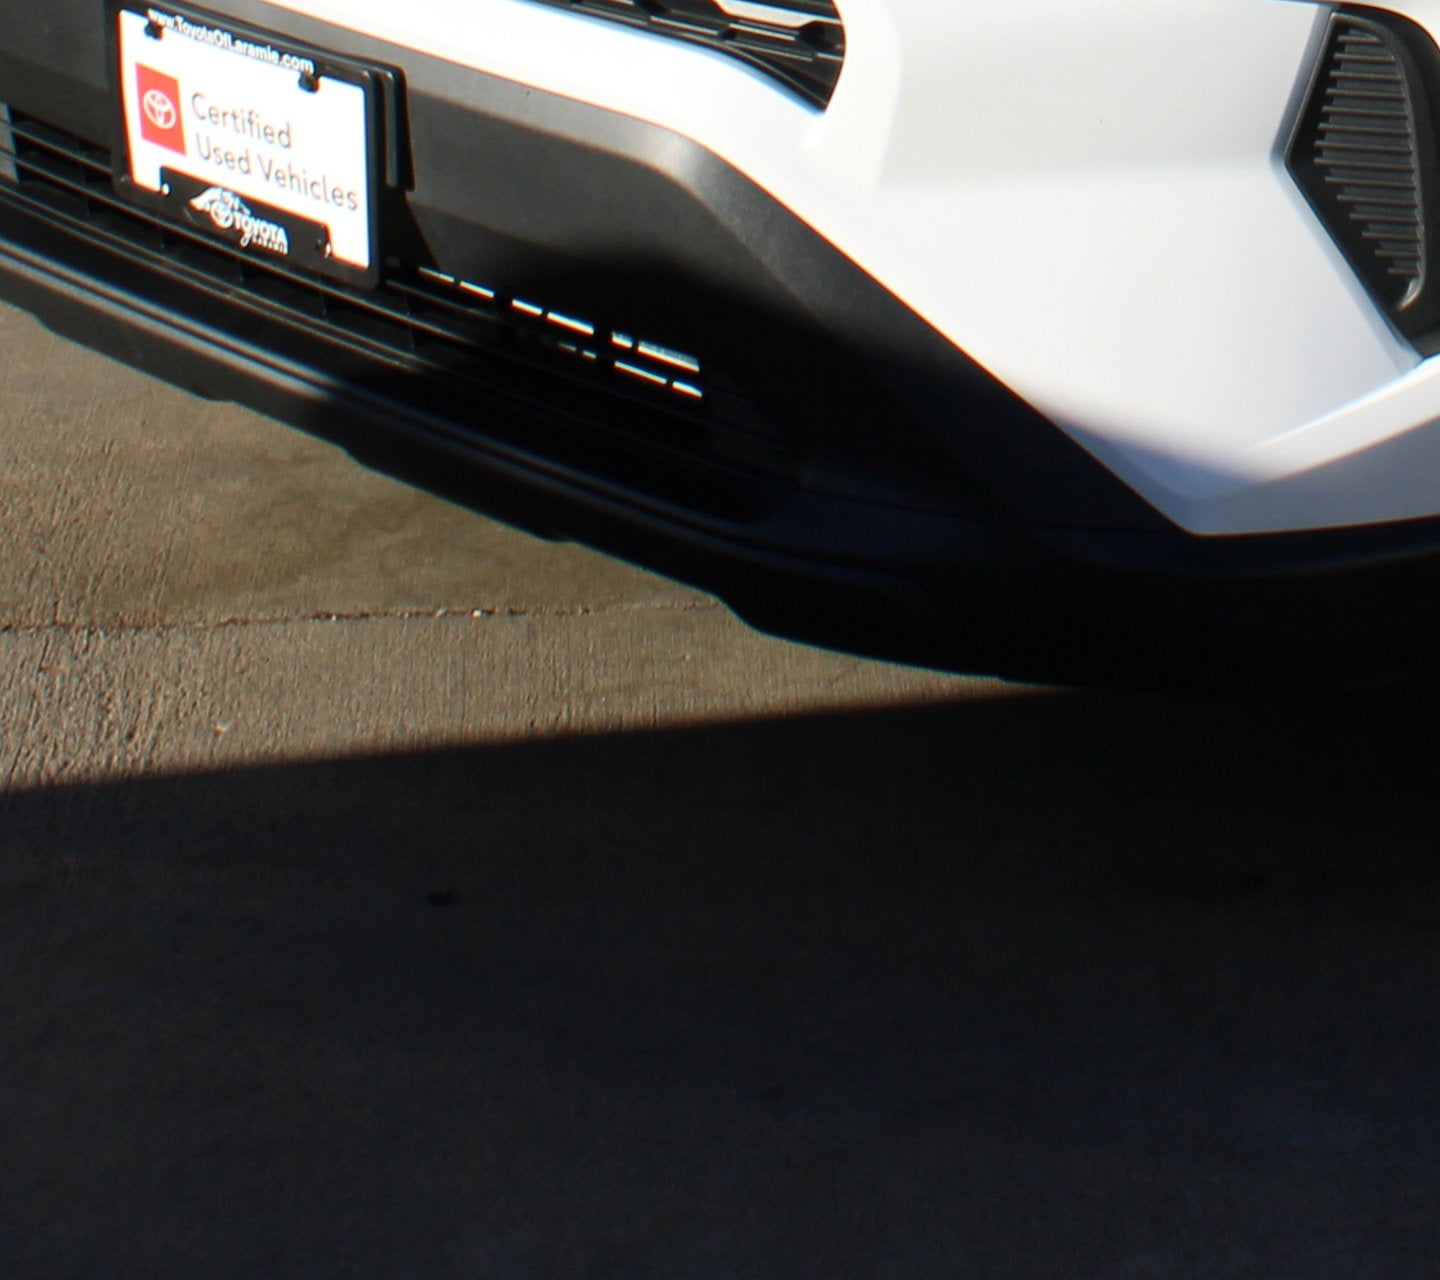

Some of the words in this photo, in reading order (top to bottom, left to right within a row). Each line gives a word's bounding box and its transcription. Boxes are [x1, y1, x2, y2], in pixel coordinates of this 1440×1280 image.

[191, 92, 294, 149] Certified
[196, 133, 252, 175] Used
[259, 149, 359, 212] Vehicles
[233, 210, 288, 244] TOYOTA
